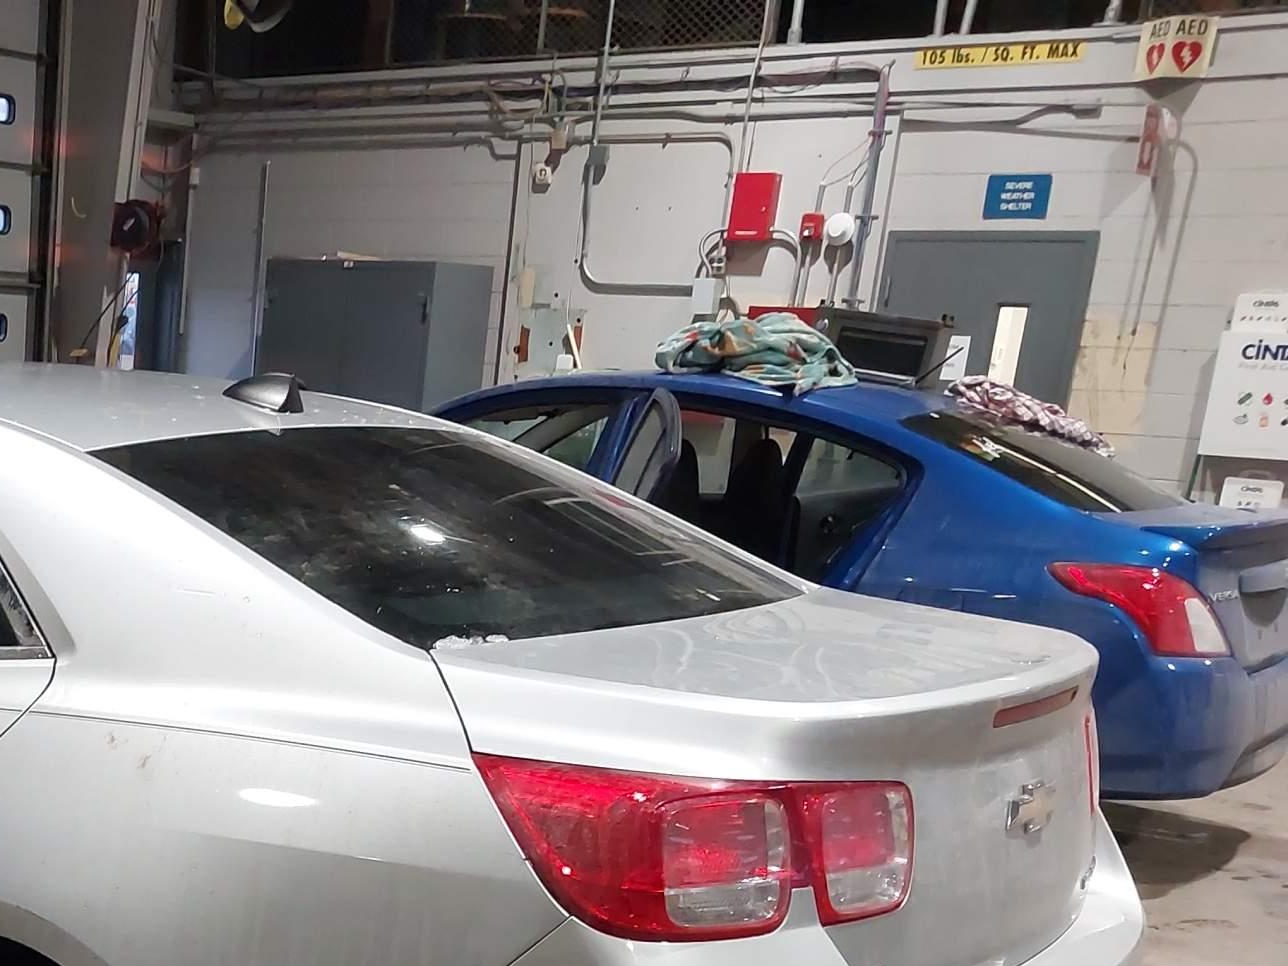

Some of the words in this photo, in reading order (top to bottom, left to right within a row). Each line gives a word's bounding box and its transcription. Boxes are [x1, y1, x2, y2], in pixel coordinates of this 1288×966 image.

[1149, 20, 1171, 40] AED
[1175, 19, 1209, 36] AED
[922, 50, 946, 65] 105
[951, 48, 975, 64] lbs.
[981, 47, 989, 63] /
[992, 47, 1014, 62] SQ.
[1020, 45, 1040, 61] FT.
[1046, 42, 1081, 59] MAX
